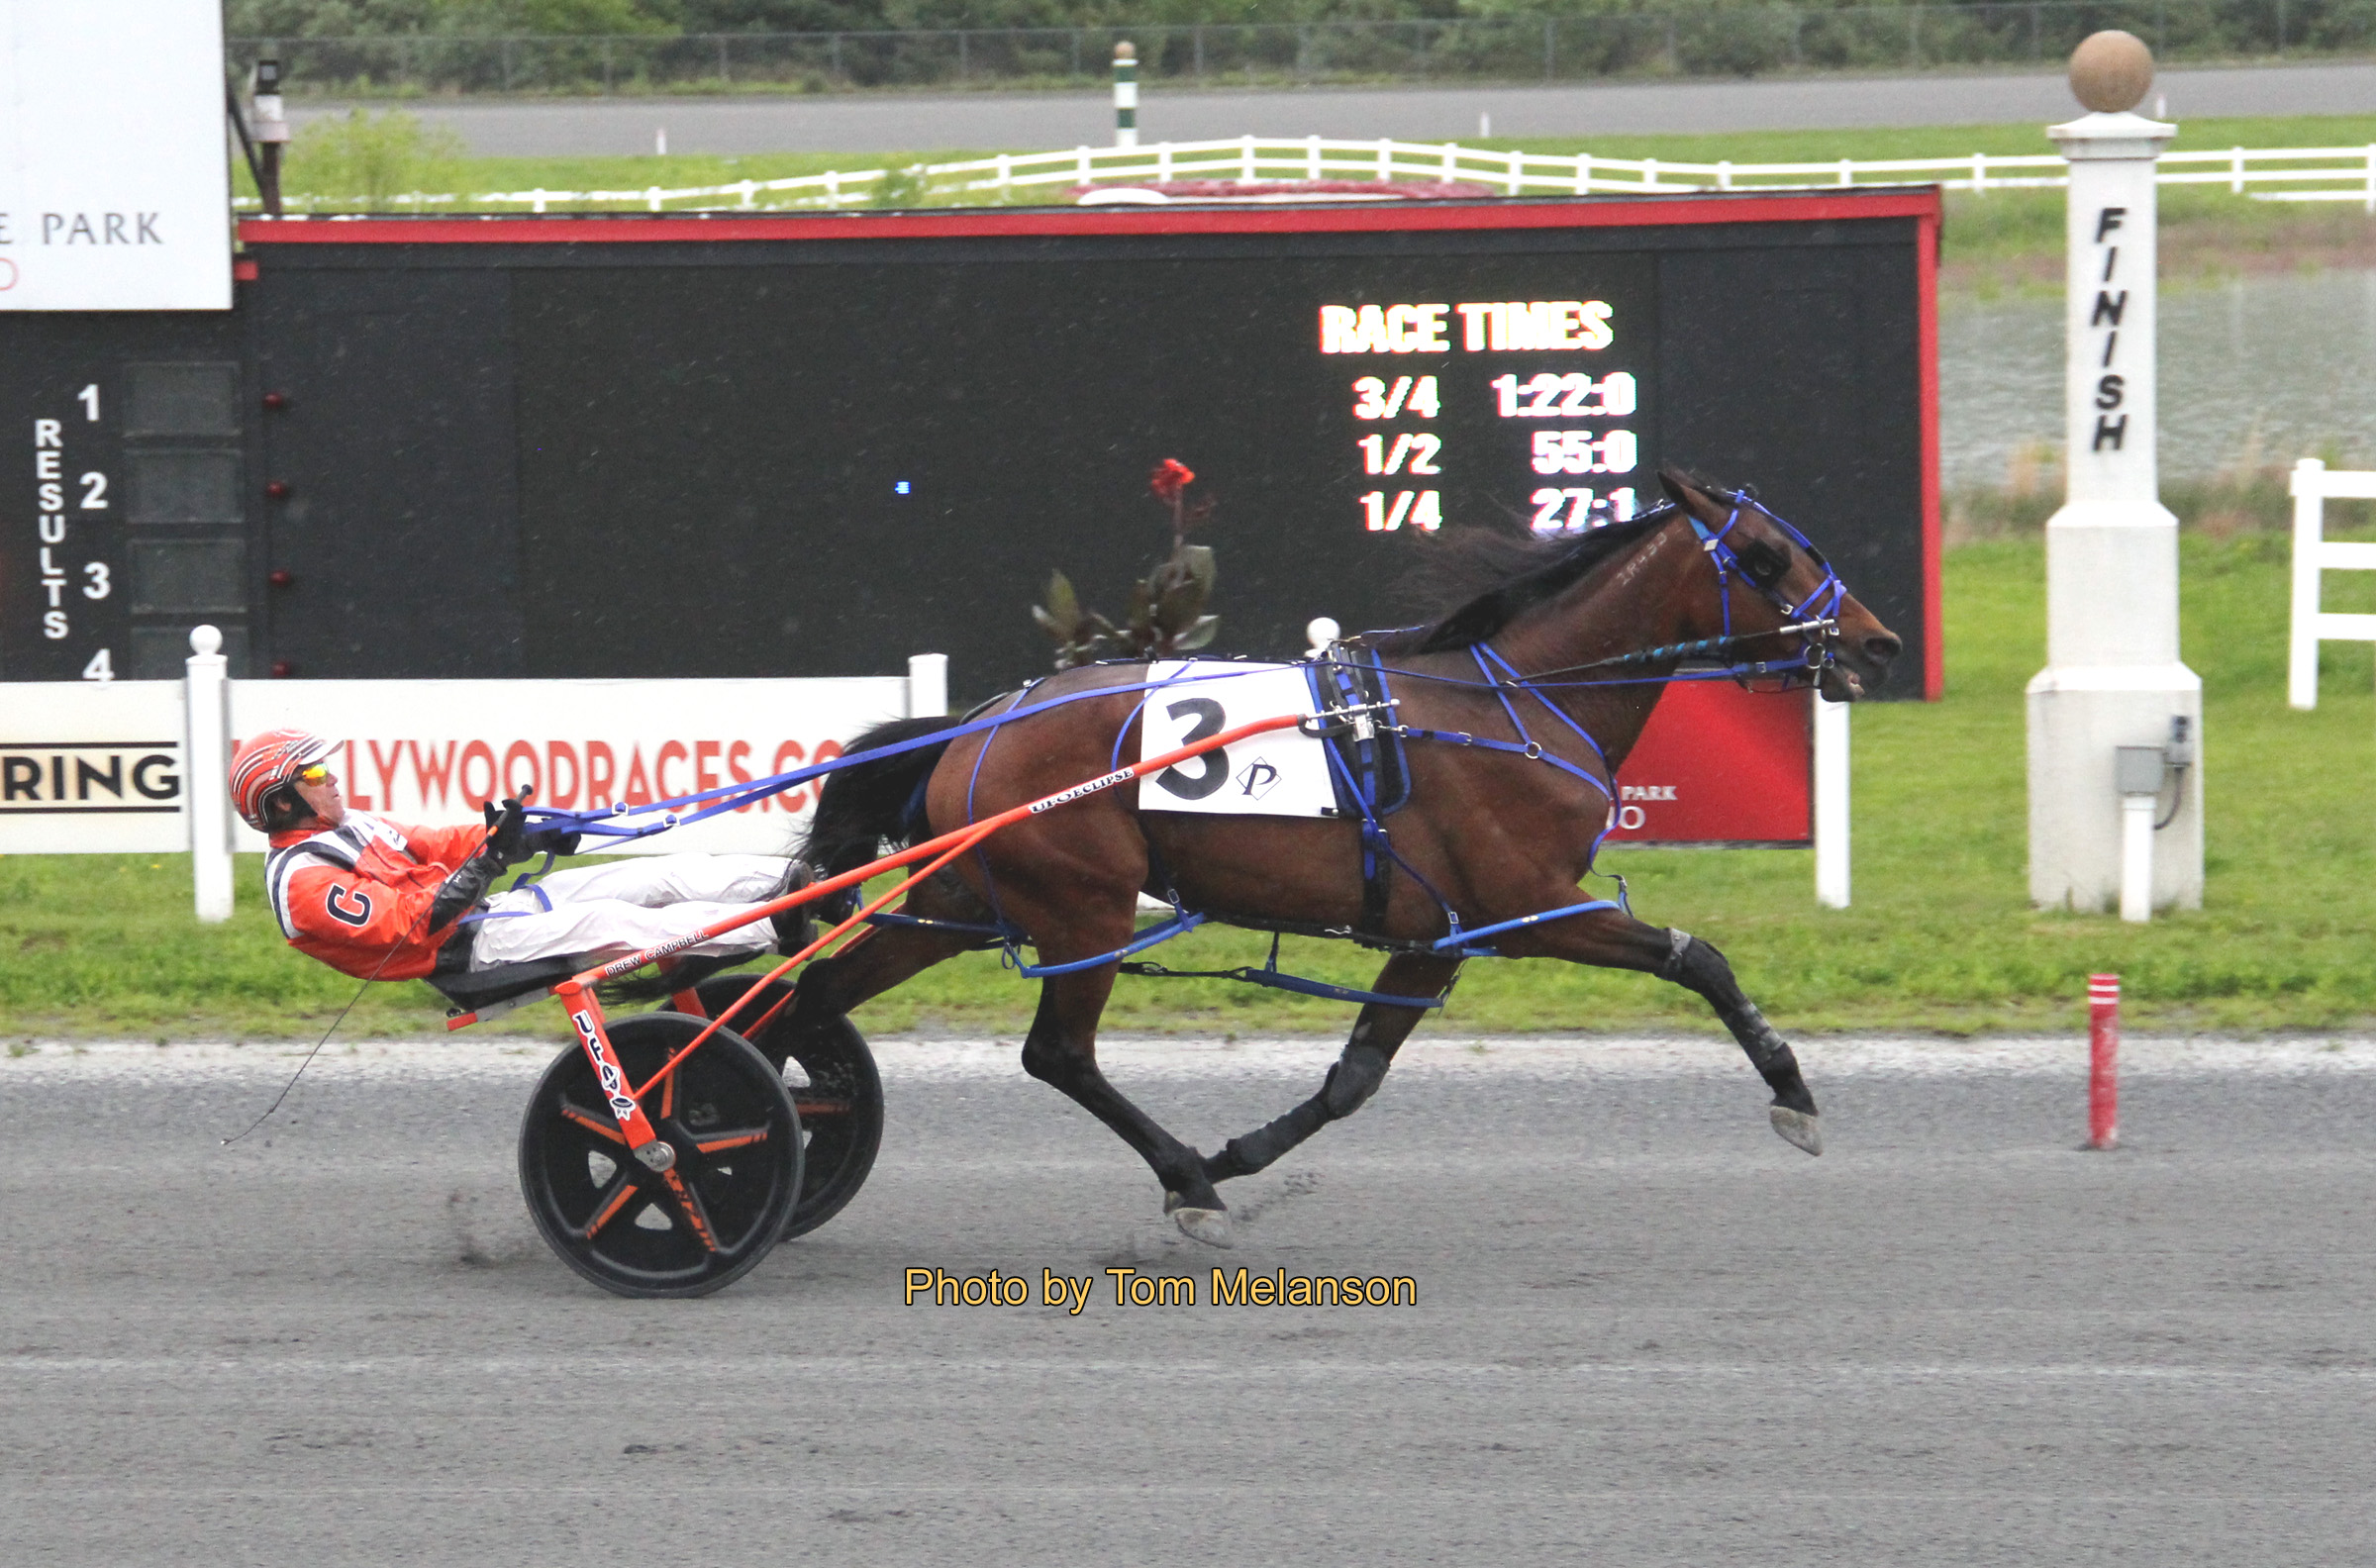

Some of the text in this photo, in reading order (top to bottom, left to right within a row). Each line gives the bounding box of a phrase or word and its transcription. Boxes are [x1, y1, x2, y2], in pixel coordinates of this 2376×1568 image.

[43, 212, 164, 245] PARK
[1319, 301, 1615, 353] RACE TIMES
[2090, 207, 2128, 452] FINISH
[77, 383, 99, 422] 1
[1352, 371, 1637, 420] 3/4 1:22:0
[1357, 430, 1637, 475] 1/2 55:0
[79, 470, 109, 510] 2
[1358, 487, 1636, 532] 1/4 27:1
[35, 419, 68, 638] RESULTS
[82, 561, 111, 599] 3
[82, 647, 115, 681] 4
[1155, 697, 1230, 801] 3
[1621, 785, 1679, 801] PARK
[327, 884, 372, 928] C
[605, 931, 708, 977] DREW CAMPBELL
